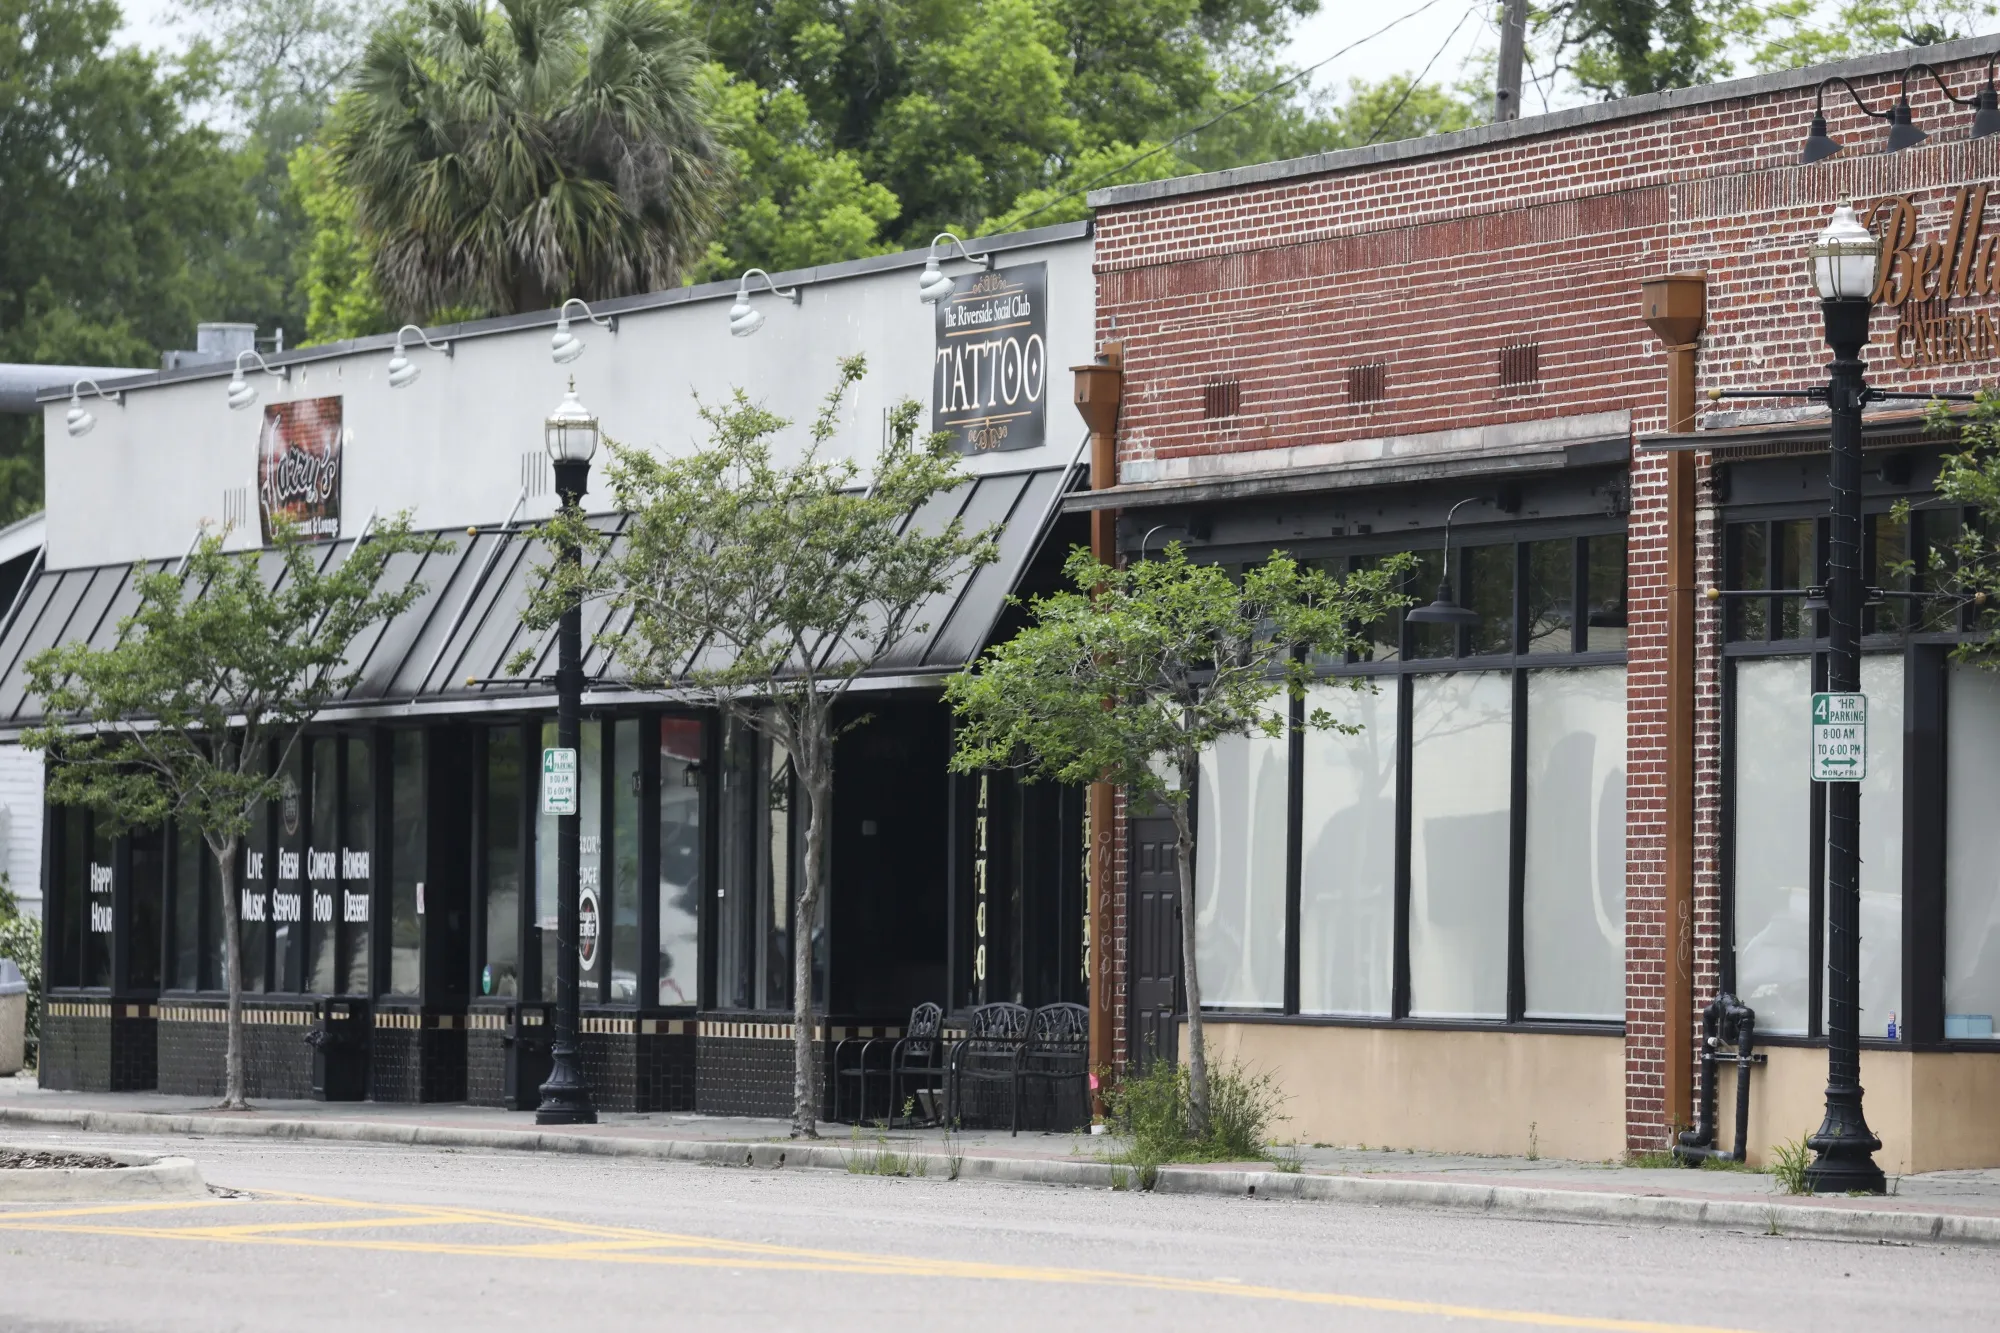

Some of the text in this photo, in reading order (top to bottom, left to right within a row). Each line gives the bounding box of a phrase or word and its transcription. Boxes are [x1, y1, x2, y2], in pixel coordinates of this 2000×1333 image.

[944, 293, 1031, 328] The Riverside Social Club
[1893, 309, 2000, 369] CATERIN
[937, 333, 1045, 414] TATTOO
[1814, 699, 1855, 720] 4 HR
[1830, 711, 1864, 722] PARKING
[1818, 744, 1827, 755] TO
[1849, 744, 1861, 755] PM
[1843, 728, 1855, 739] AM
[545, 753, 553, 770] 4
[554, 762, 574, 770] PARKING
[247, 847, 263, 879] LIVE
[279, 847, 299, 880] FRESH
[307, 846, 336, 880] COMFOR
[976, 775, 987, 981] ATTOO
[91, 902, 112, 933] HOUR
[241, 888, 266, 922] MUSIC
[313, 889, 332, 922] FOOD
[579, 923, 595, 937] EDGE
